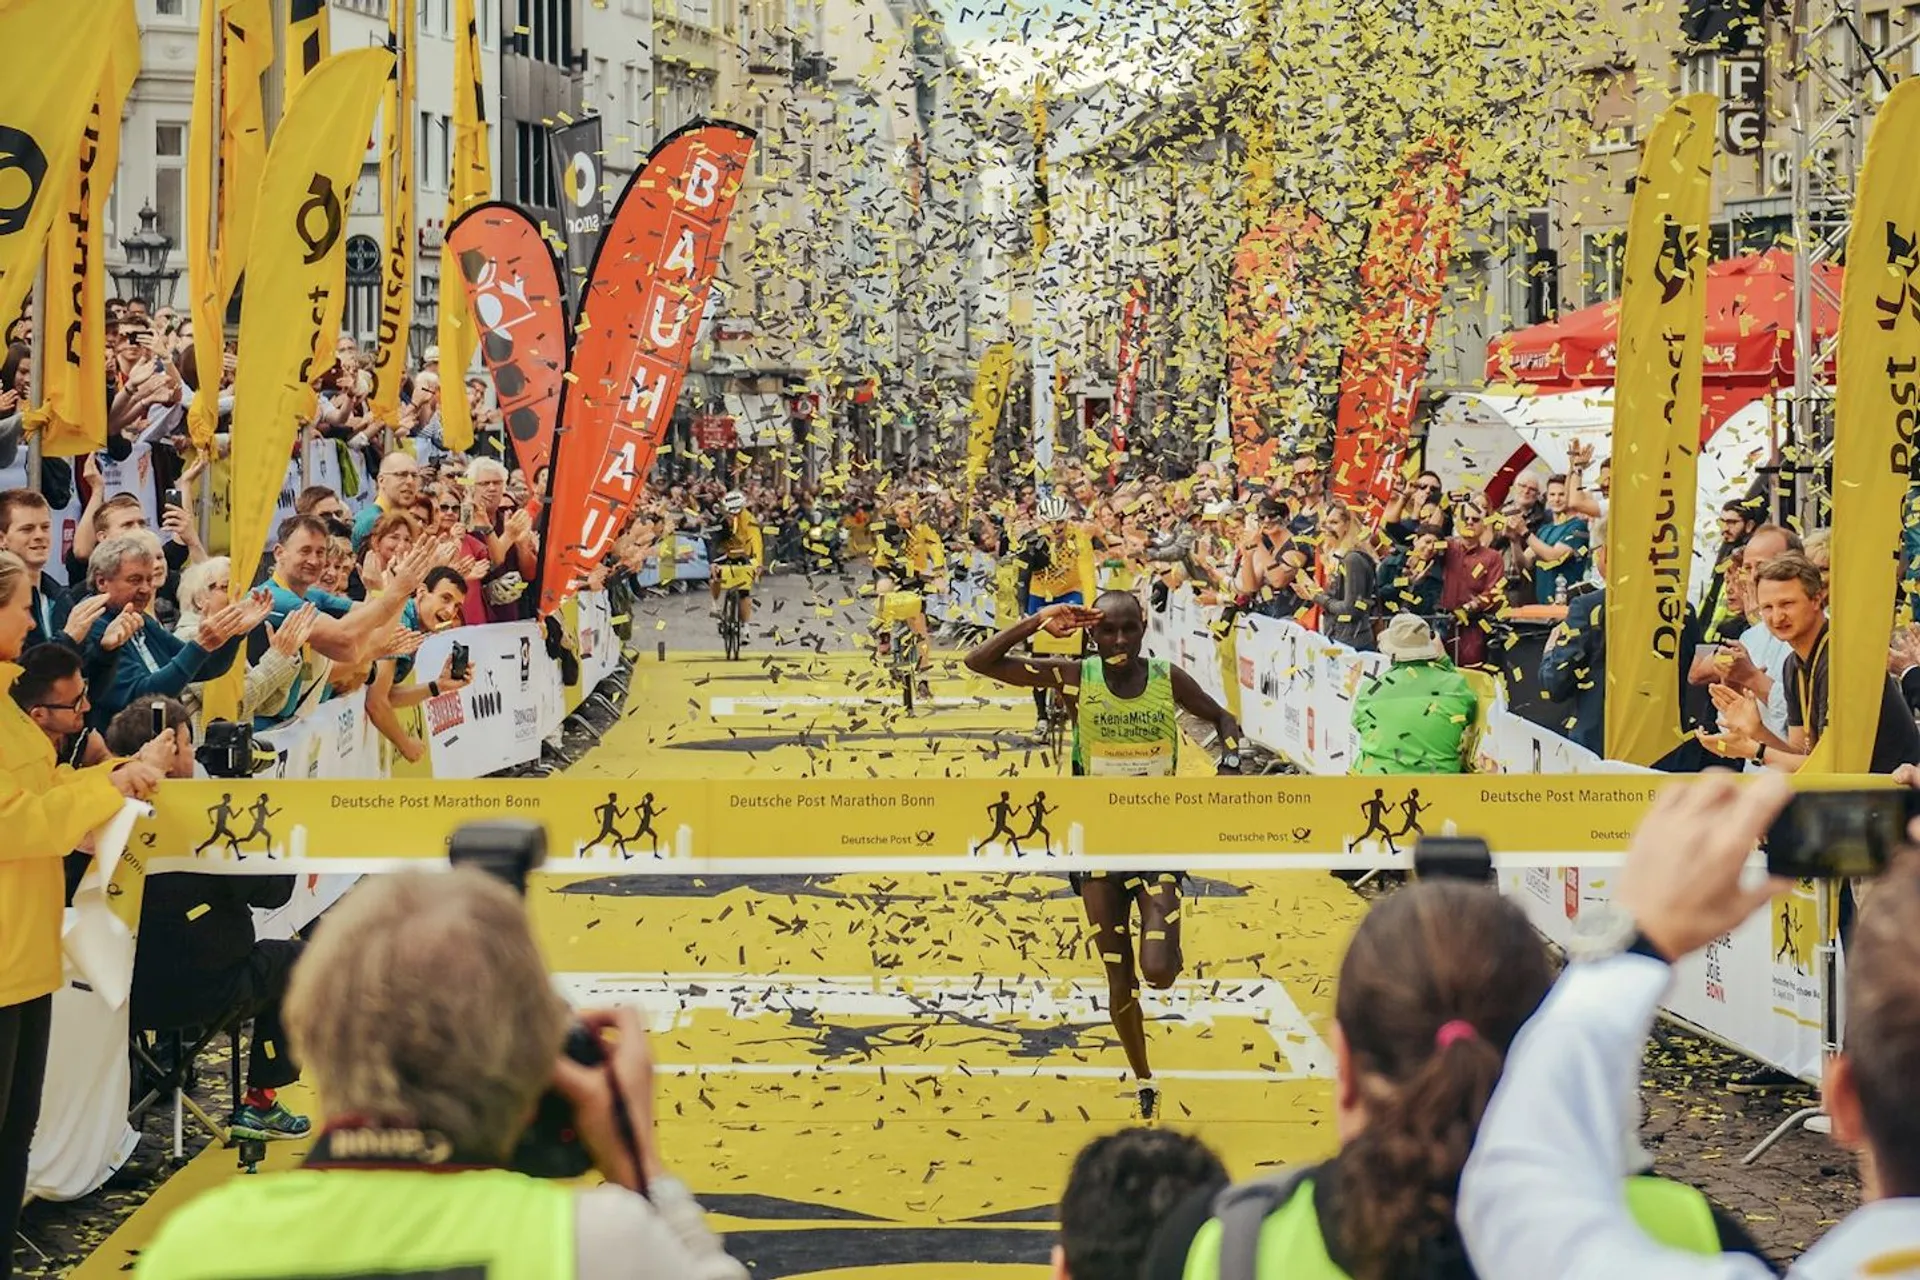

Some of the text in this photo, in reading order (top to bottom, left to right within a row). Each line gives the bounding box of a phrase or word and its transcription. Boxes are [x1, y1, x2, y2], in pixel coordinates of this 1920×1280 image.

[562, 156, 719, 602] BAUHAU
[330, 794, 540, 808] Deutsche Post Marathon Bonn
[730, 793, 935, 808] Deutsche Post Marathon Bonn
[1108, 791, 1311, 806] Deutsche Post Marathon Bonn
[1480, 789, 1541, 803] Deutsche
[1546, 790, 1574, 802] Post
[1579, 789, 1643, 802] Marathon
[841, 834, 912, 845] Deutsche Post
[1219, 831, 1288, 842] Deutsche Post
[1590, 830, 1631, 840] Deutsch
